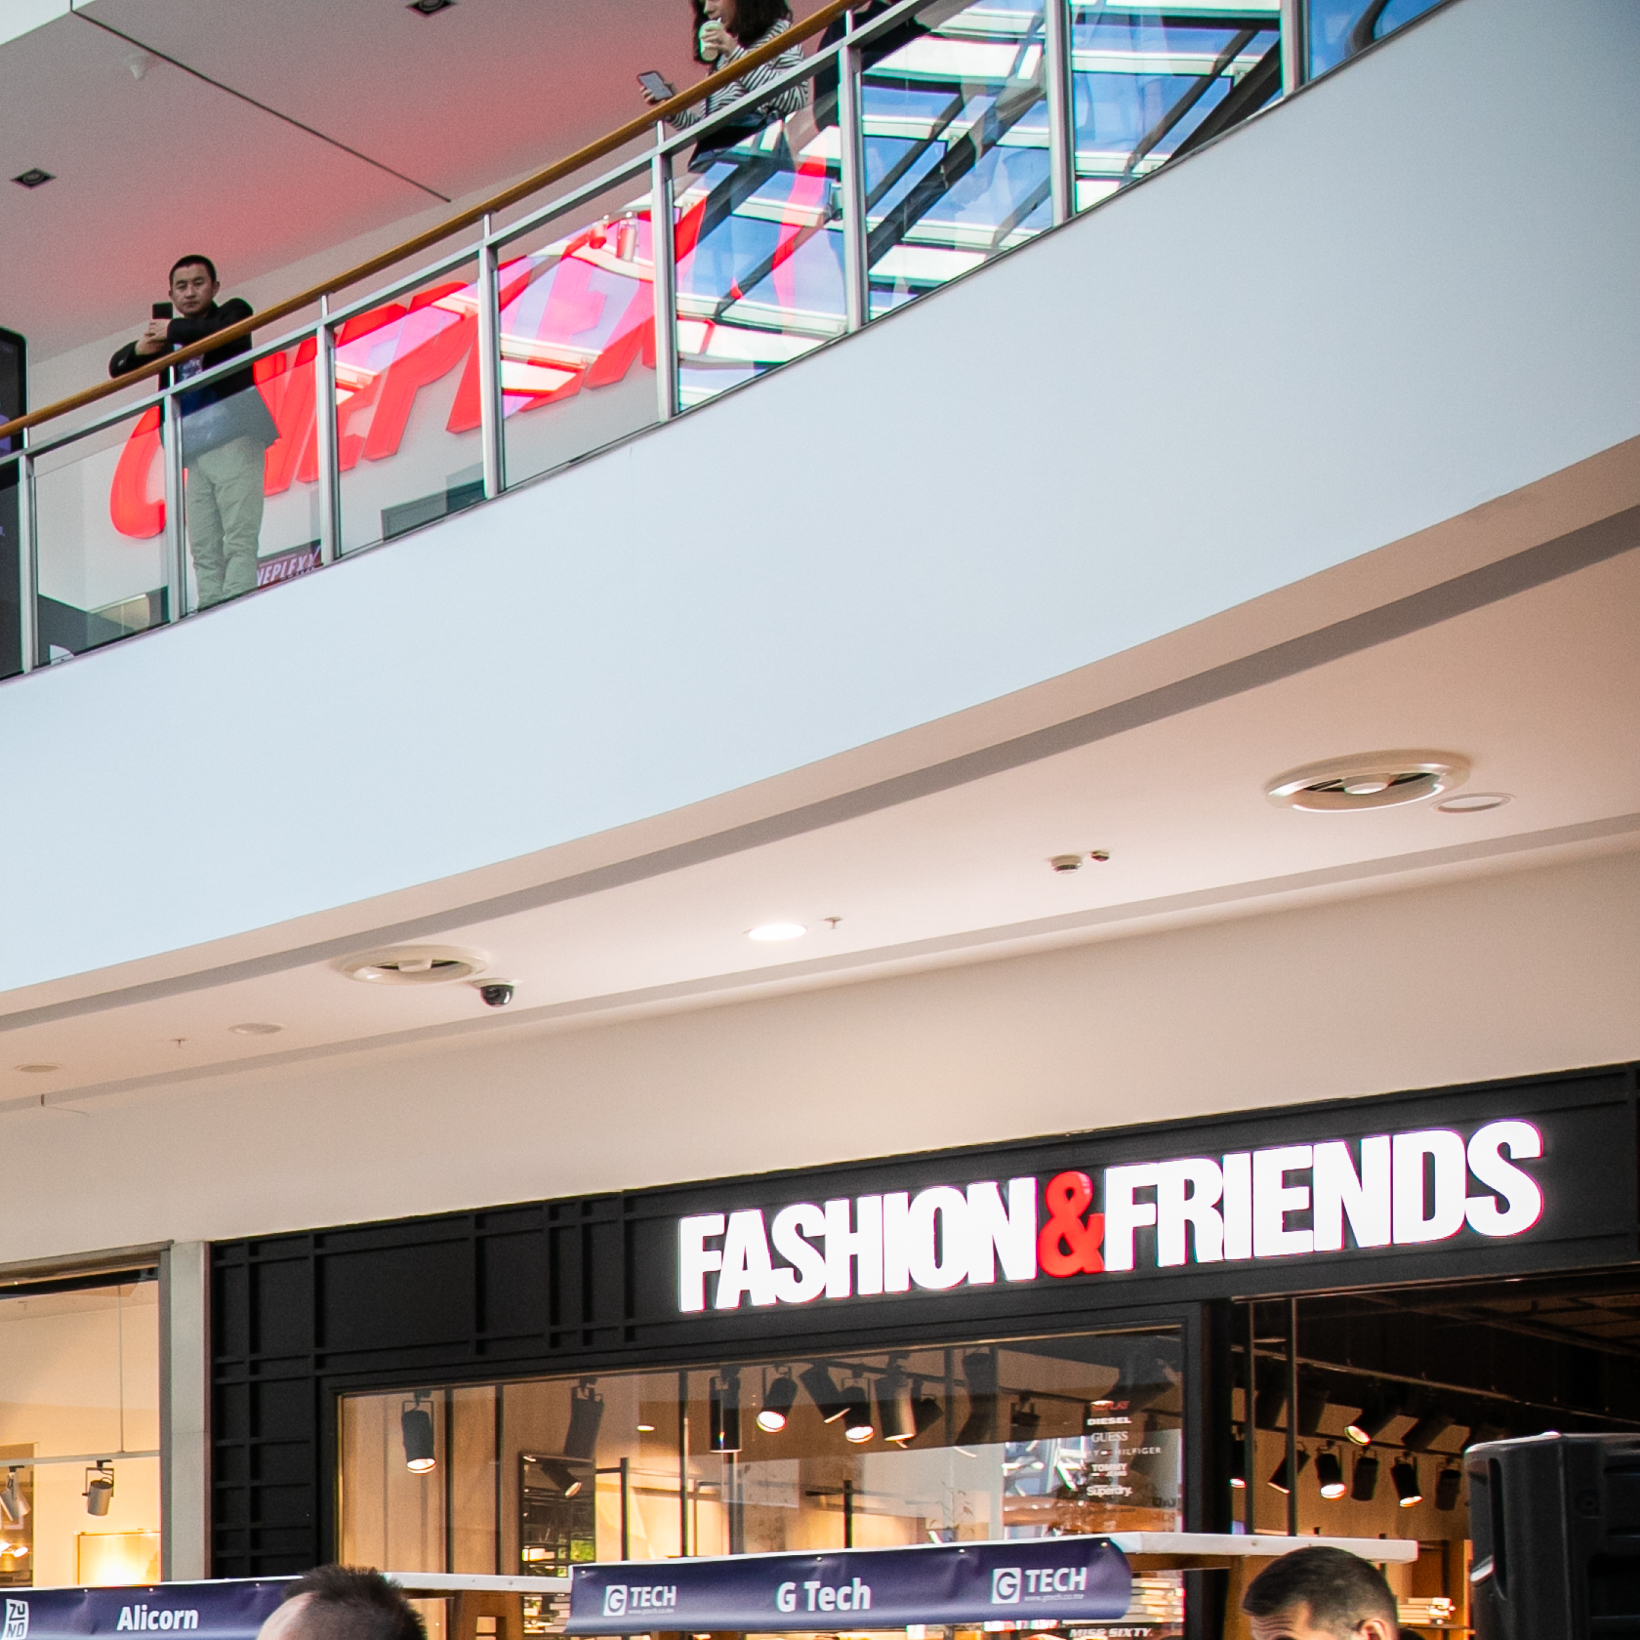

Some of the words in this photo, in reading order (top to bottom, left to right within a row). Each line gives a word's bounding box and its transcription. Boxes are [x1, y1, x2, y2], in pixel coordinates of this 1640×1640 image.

[1087, 1417, 1131, 1426] DIESEL
[1091, 1431, 1128, 1443] GUESS
[1092, 1463, 1127, 1473] TOMMY
[1086, 1485, 1132, 1498] Superdry.
[1024, 1567, 1087, 1592] TECH
[630, 1585, 676, 1608] TECH
[777, 1582, 796, 1612] G
[804, 1578, 871, 1611] Tech
[117, 1605, 199, 1630] Alicorn
